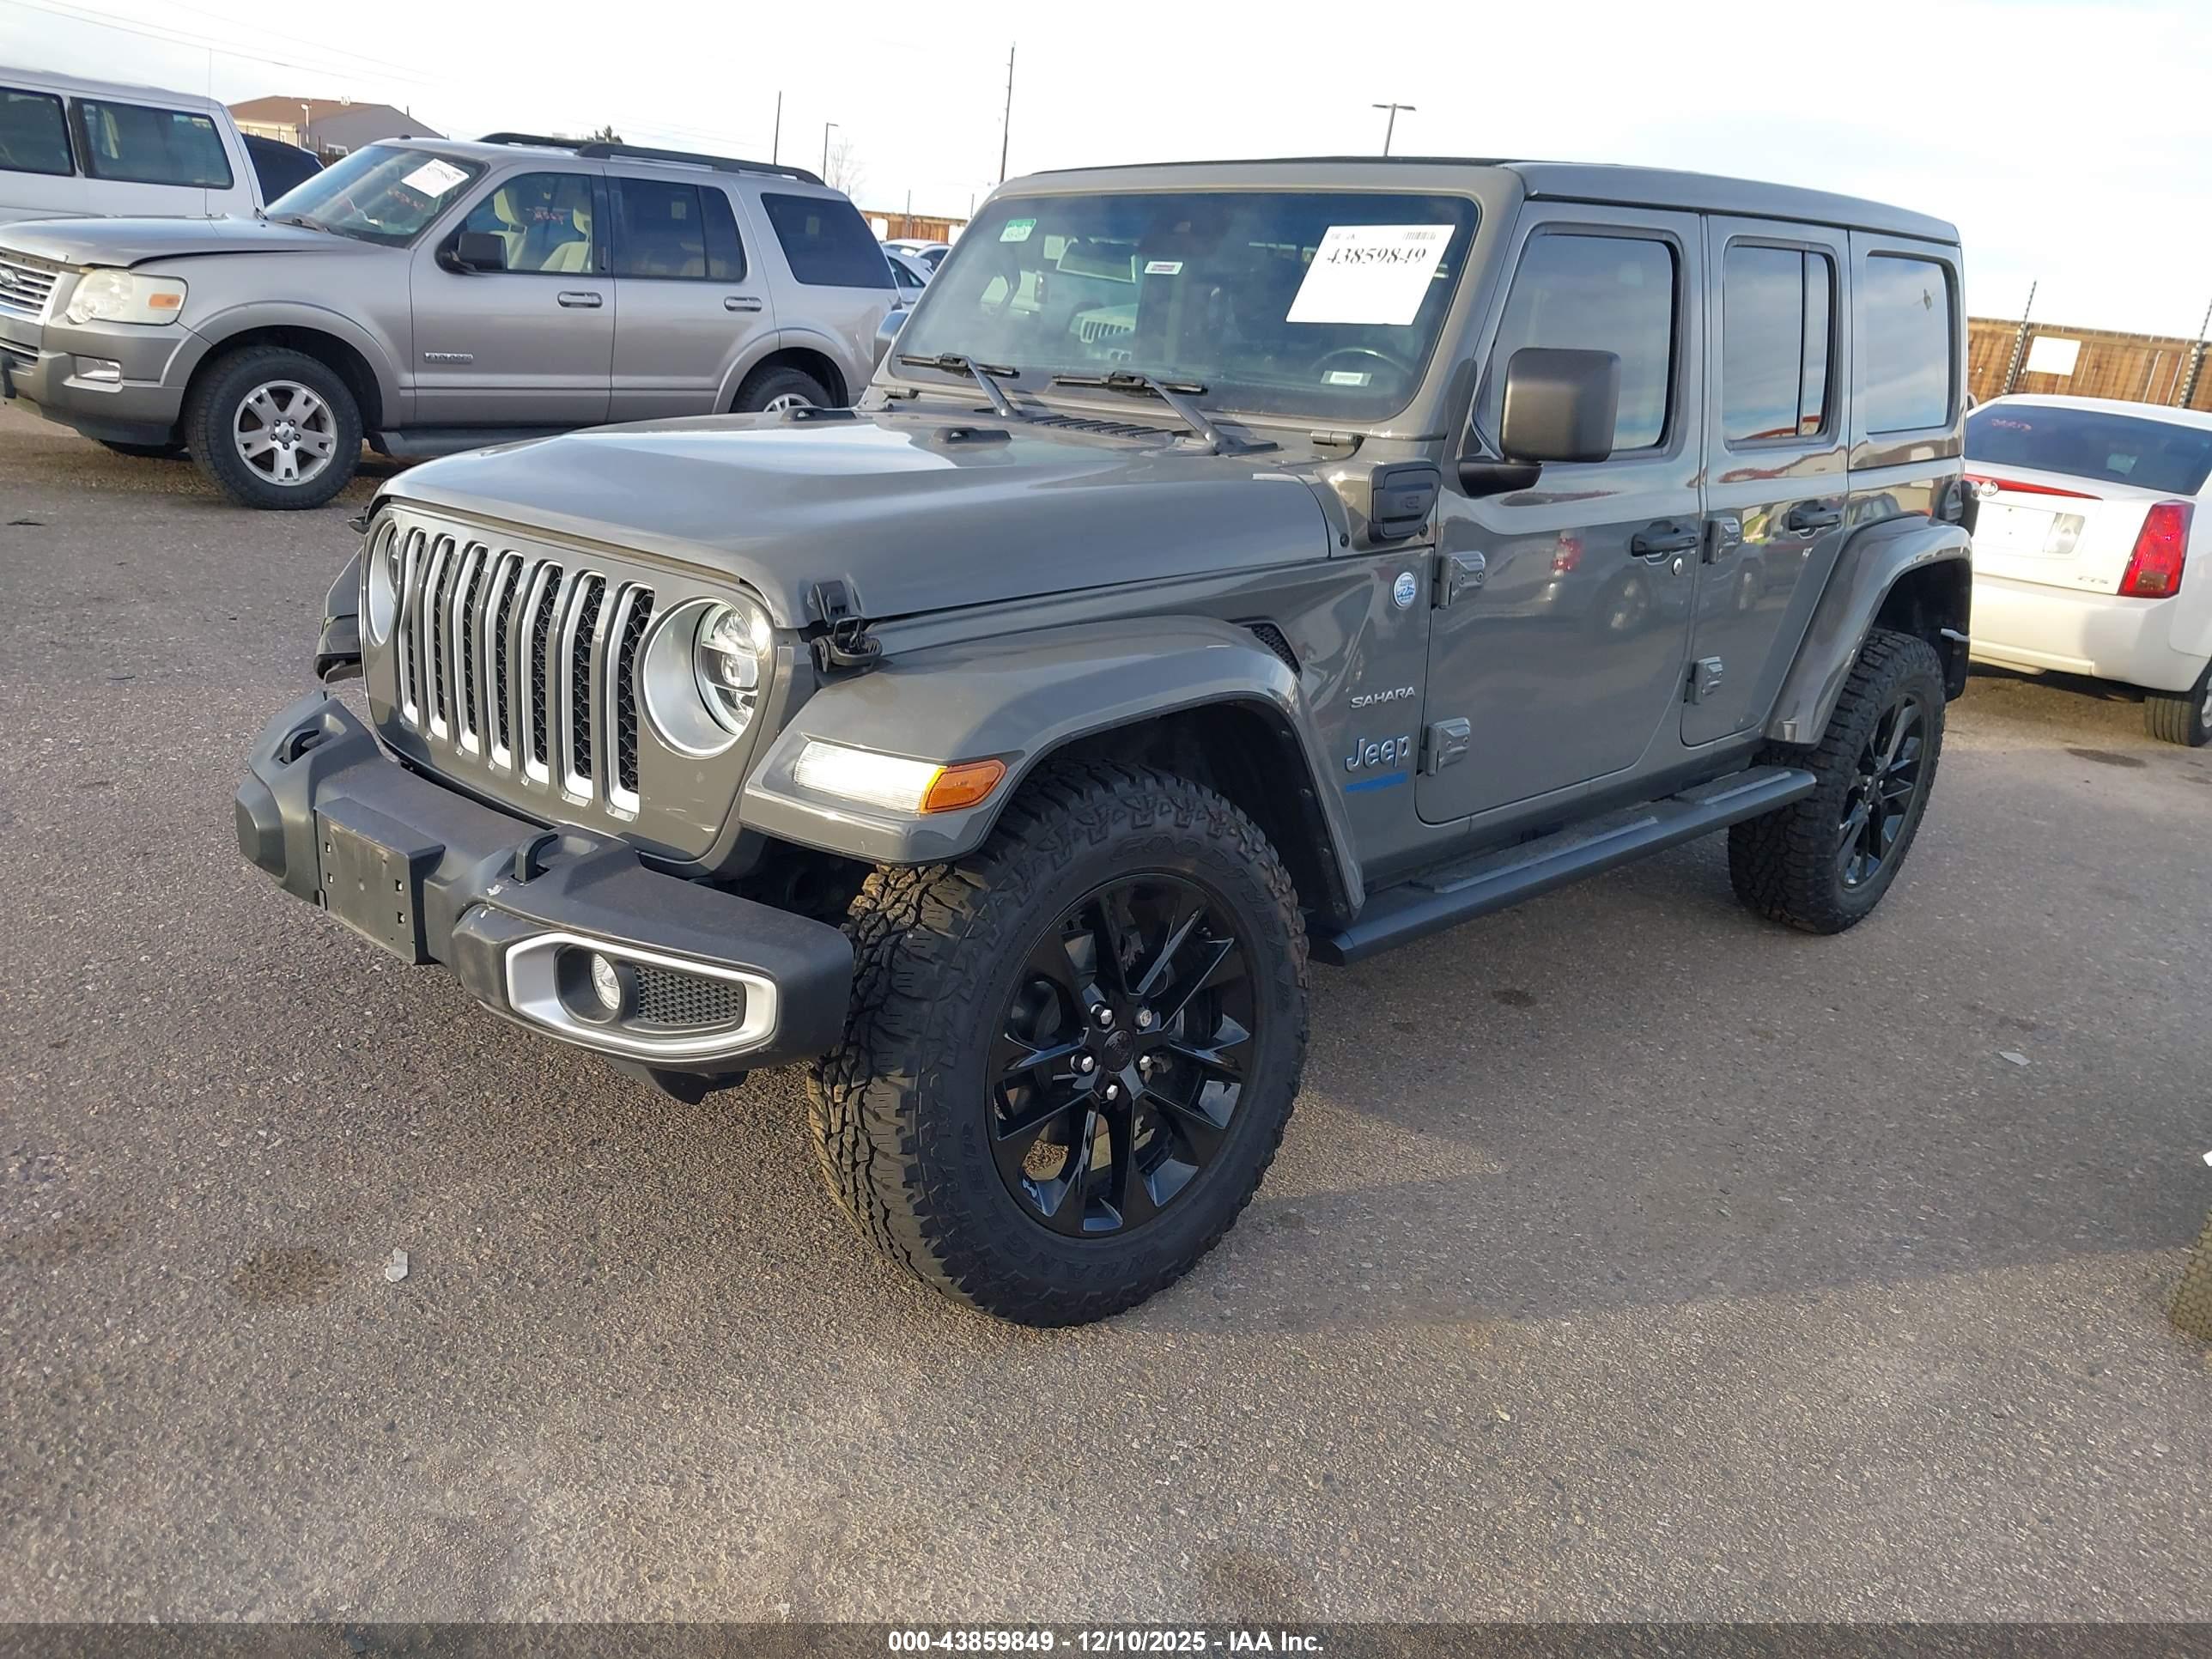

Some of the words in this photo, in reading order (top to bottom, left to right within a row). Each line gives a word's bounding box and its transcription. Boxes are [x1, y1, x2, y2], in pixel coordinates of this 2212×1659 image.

[1327, 247, 1428, 264] 43859849
[1351, 686, 1415, 708] SAHARA
[1346, 735, 1411, 771] Jeep
